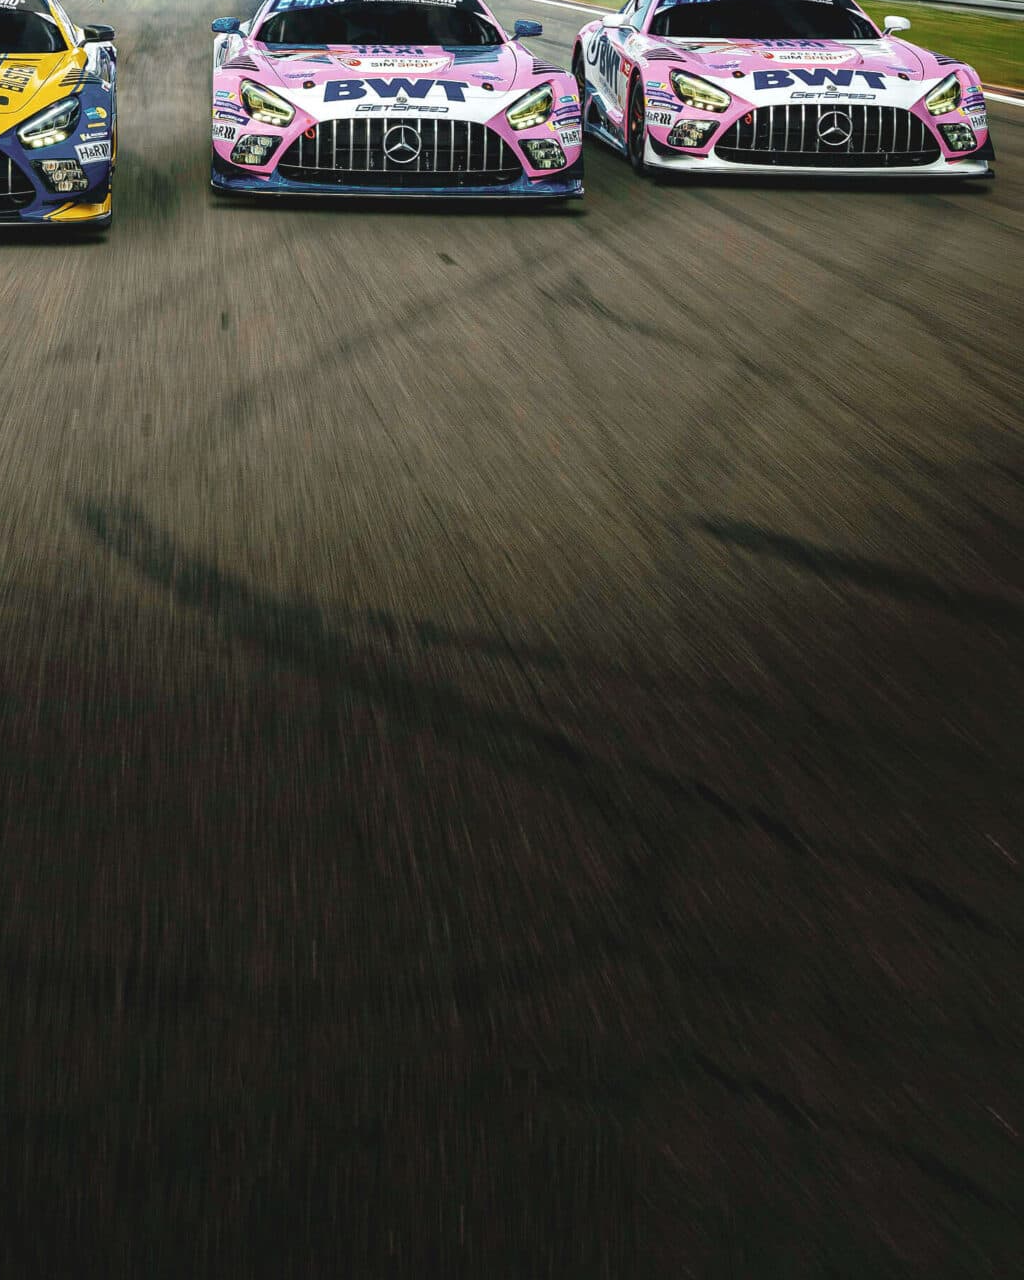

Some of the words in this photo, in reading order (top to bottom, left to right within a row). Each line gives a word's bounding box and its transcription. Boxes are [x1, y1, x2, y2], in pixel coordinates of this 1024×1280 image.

[323, 78, 469, 102] BWT
[752, 68, 887, 90] BWT
[79, 144, 100, 159] H&R
